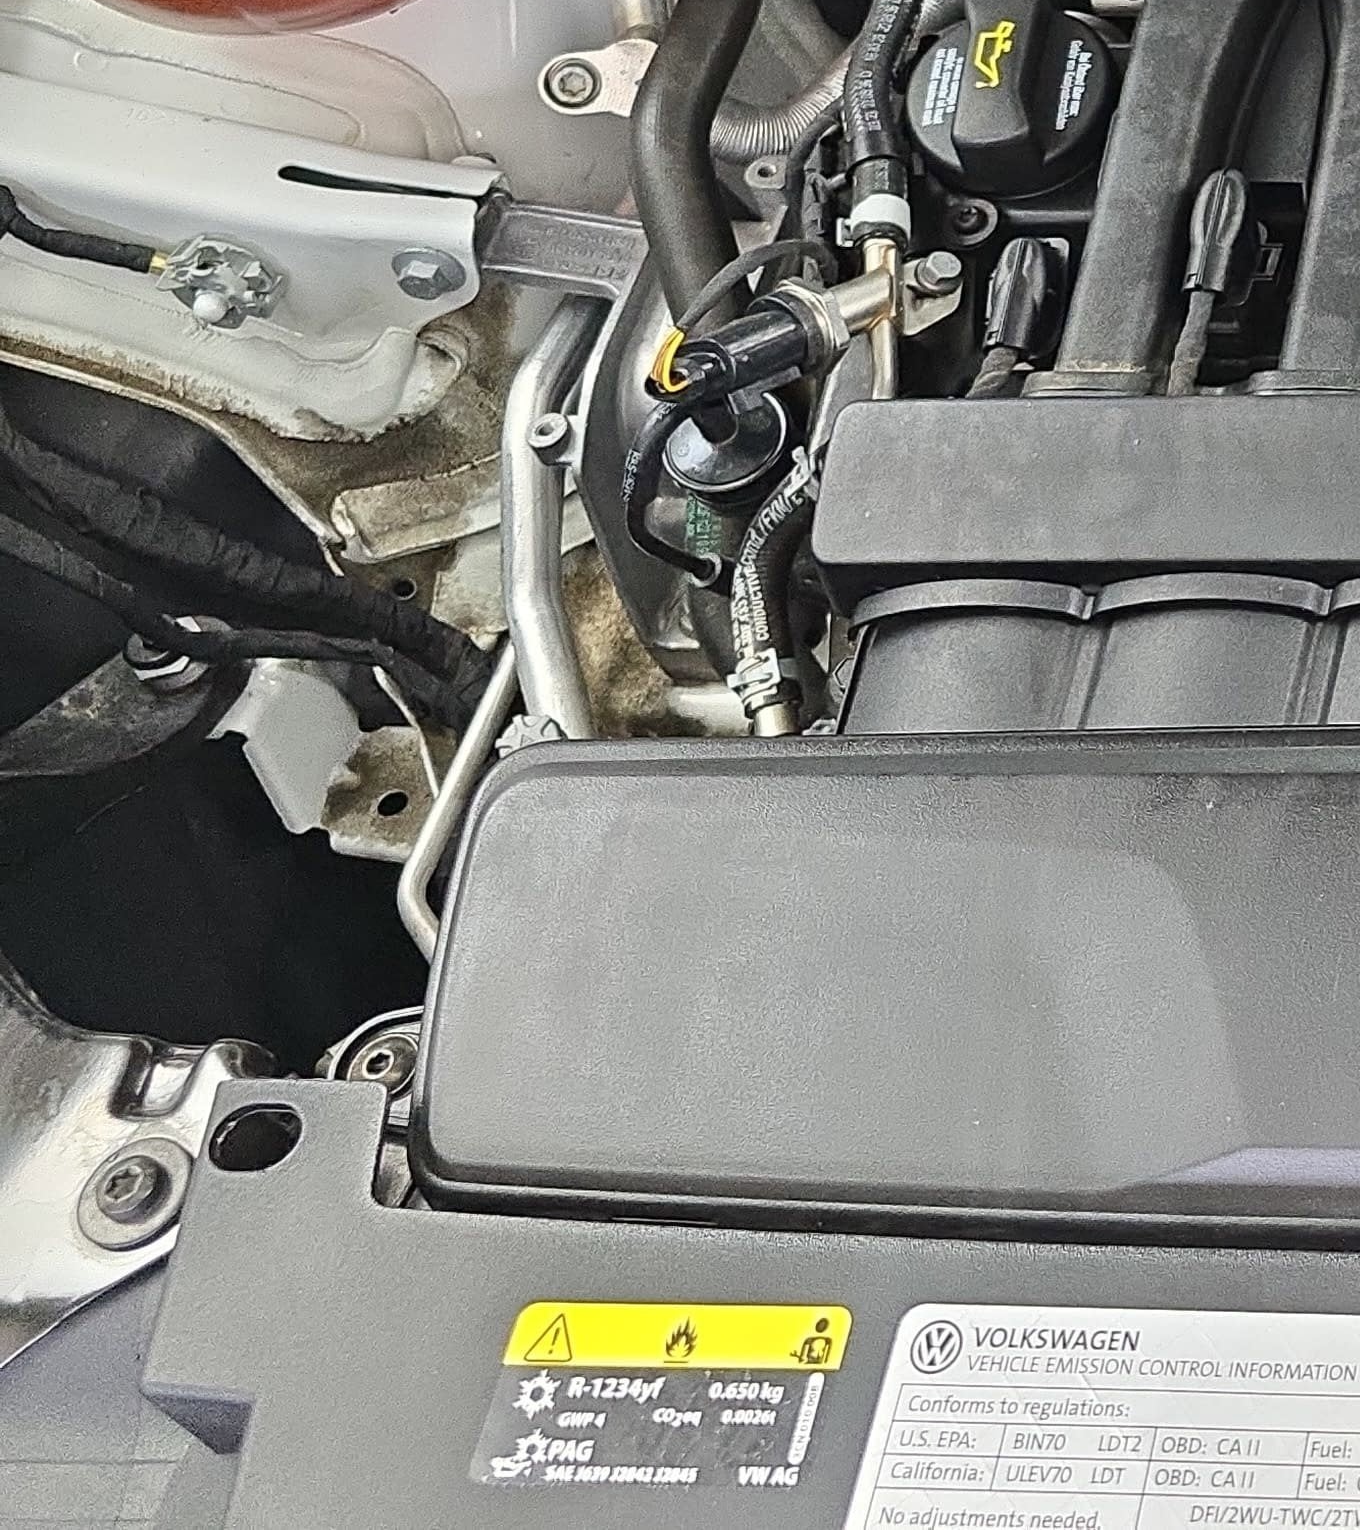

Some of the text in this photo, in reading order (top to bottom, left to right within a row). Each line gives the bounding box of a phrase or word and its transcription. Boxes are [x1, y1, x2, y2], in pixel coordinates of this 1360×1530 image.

[747, 560, 770, 642] CONDUCTIVE
[974, 1327, 1141, 1352] VOLKSWAGEN
[967, 1354, 1359, 1381] VEHICLE EMISSION CONTROL INFORMATION
[567, 1376, 785, 1405] R-1234yf 0.650 kg
[908, 1394, 1131, 1420] Conforms to regulations:
[557, 1411, 596, 1428] GWP
[900, 1430, 977, 1450] U.S. EPA:
[1012, 1433, 1142, 1452] BIN70 LDT2
[1160, 1437, 1207, 1455] OBD:
[1216, 1438, 1242, 1456] CA
[1309, 1441, 1353, 1459] Fuel:
[548, 1439, 596, 1462] PAG
[543, 1465, 576, 1482] SAE
[738, 1466, 800, 1486] VW AG
[890, 1461, 985, 1482] California:
[1005, 1466, 1126, 1484] ULEV70 LDT
[1154, 1468, 1201, 1487] OBD:
[1210, 1470, 1236, 1488] CA
[1303, 1473, 1348, 1491] Fuel:
[880, 1506, 1101, 1530] No adjustments needed.
